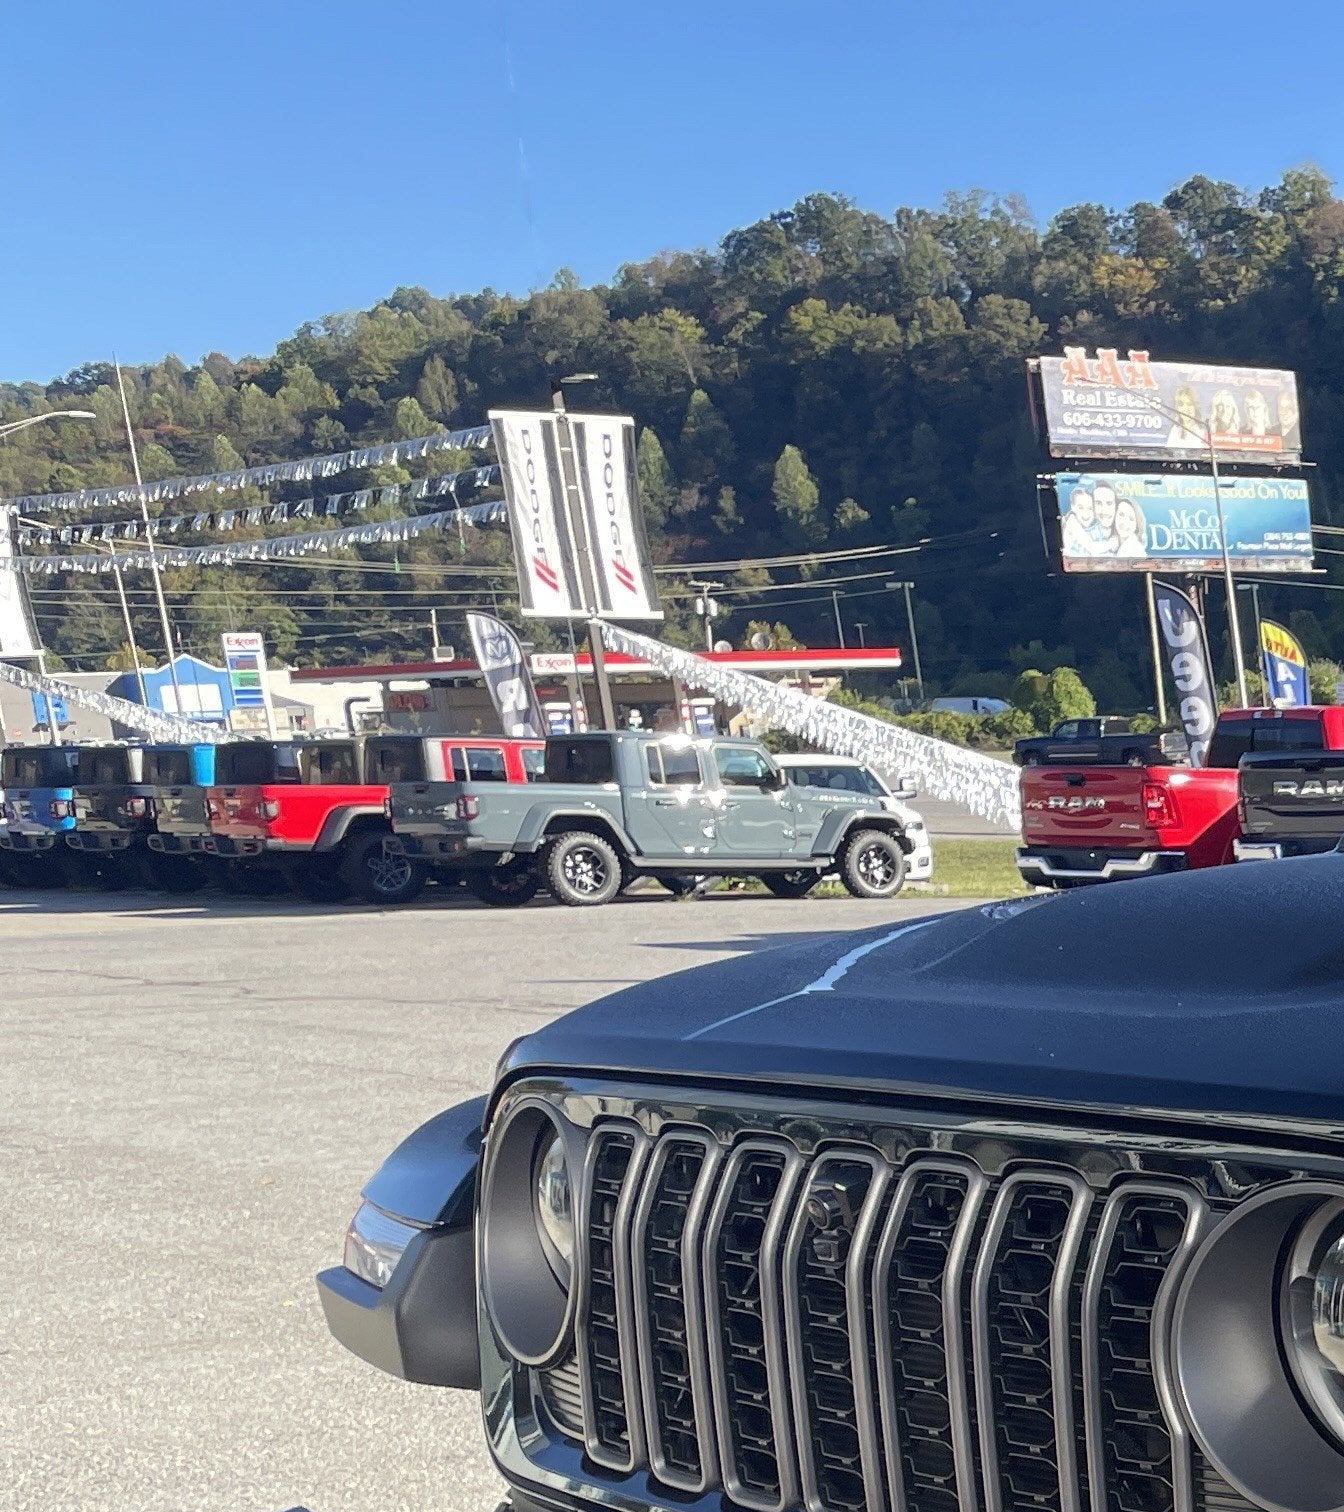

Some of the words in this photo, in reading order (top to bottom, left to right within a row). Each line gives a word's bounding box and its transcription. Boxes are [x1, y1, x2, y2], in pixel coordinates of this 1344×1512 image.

[1061, 346, 1159, 390] AAA
[1061, 389, 1101, 405] Real
[1104, 391, 1162, 409] Estate
[1062, 411, 1162, 429] 606-433-9700
[1258, 482, 1279, 500] On
[537, 657, 572, 670] Exxon
[1048, 796, 1106, 810] RAM
